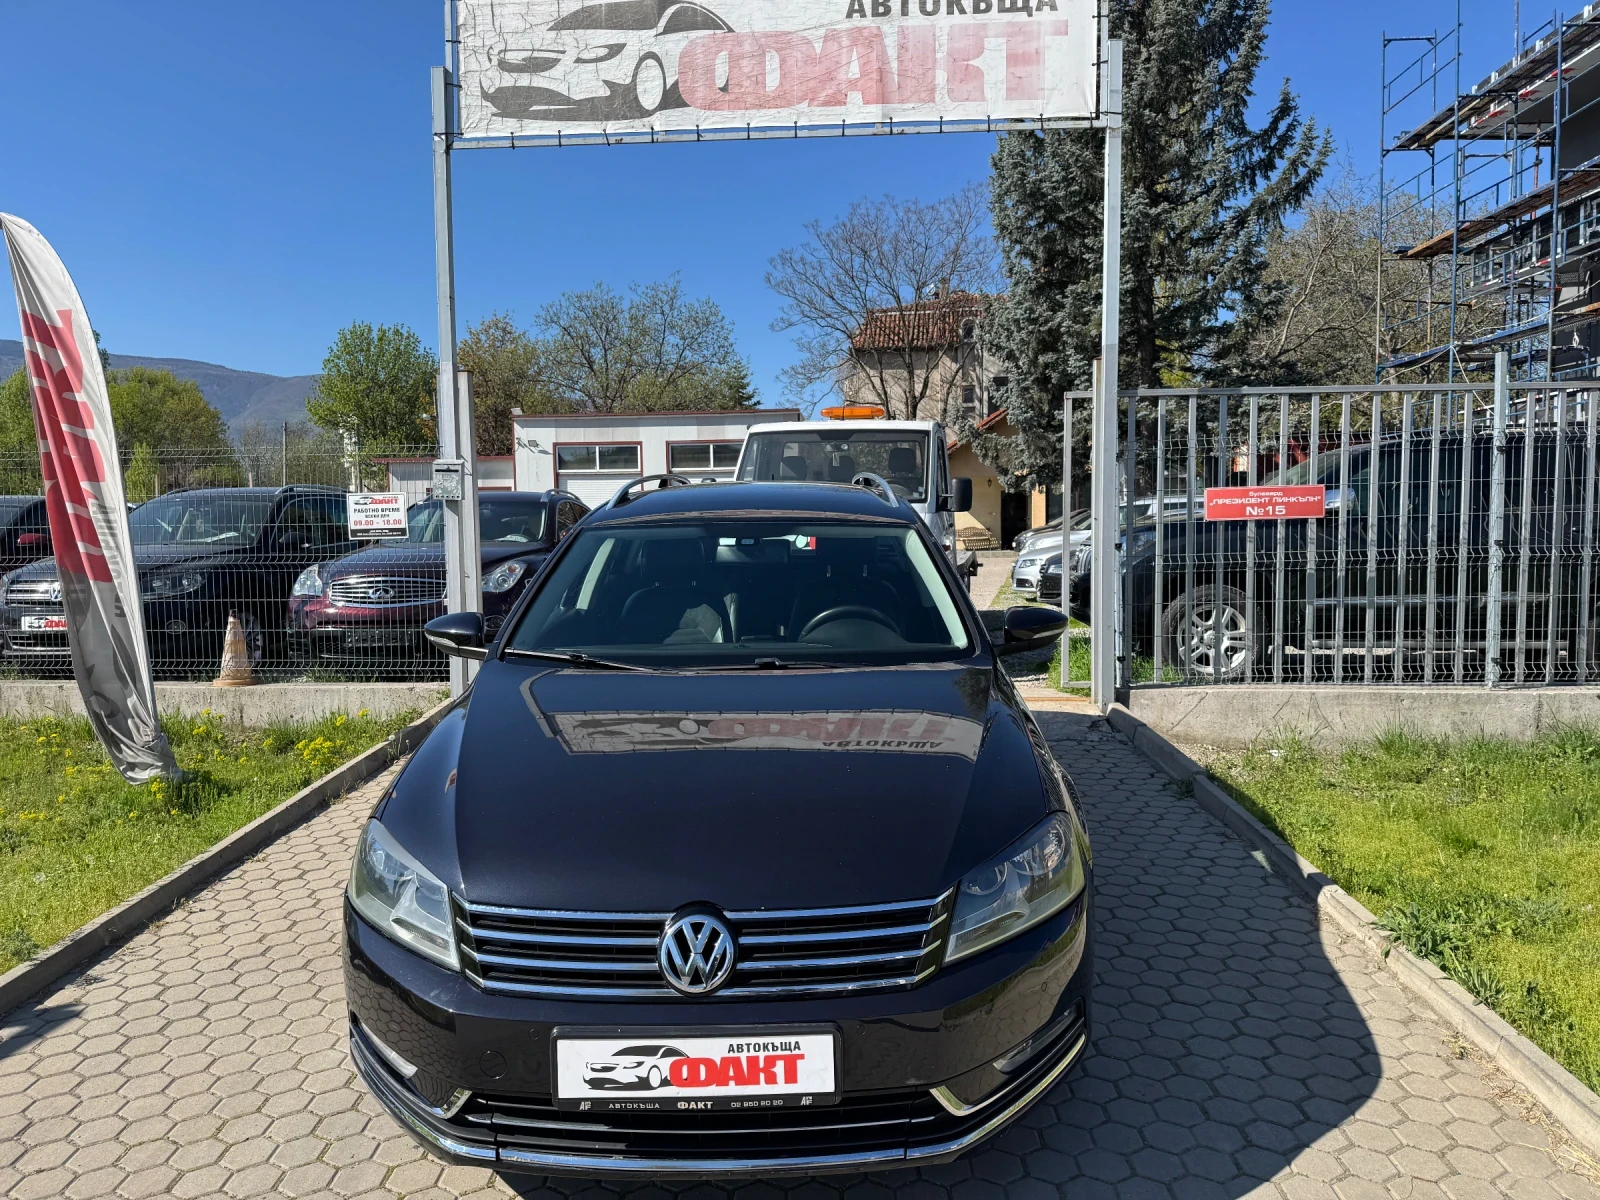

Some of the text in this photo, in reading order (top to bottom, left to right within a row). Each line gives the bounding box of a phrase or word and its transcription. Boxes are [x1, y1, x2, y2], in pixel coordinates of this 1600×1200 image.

[678, 19, 1069, 111] ФАКТ
[727, 1040, 801, 1054] АВТОКЪЩА
[668, 1053, 805, 1088] ФАКТ
[677, 1101, 714, 1110] ФАКТ
